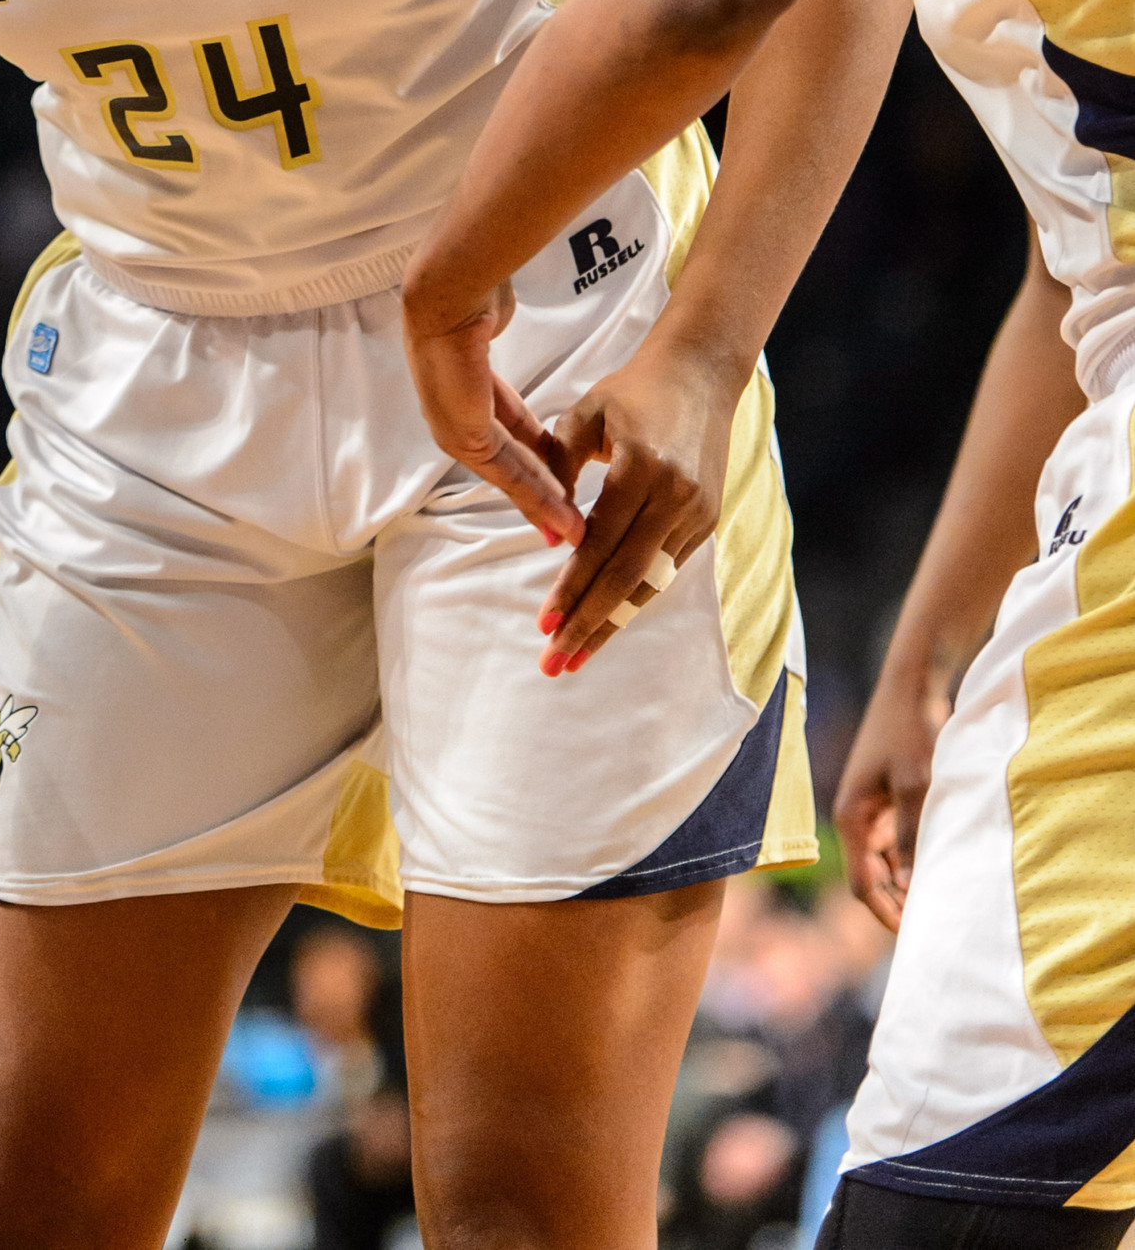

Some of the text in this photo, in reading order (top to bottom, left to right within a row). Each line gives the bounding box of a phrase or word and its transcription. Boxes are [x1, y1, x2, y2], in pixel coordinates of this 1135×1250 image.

[59, 14, 323, 171] 24
[568, 218, 620, 276] R
[573, 238, 645, 295] RUSSELL
